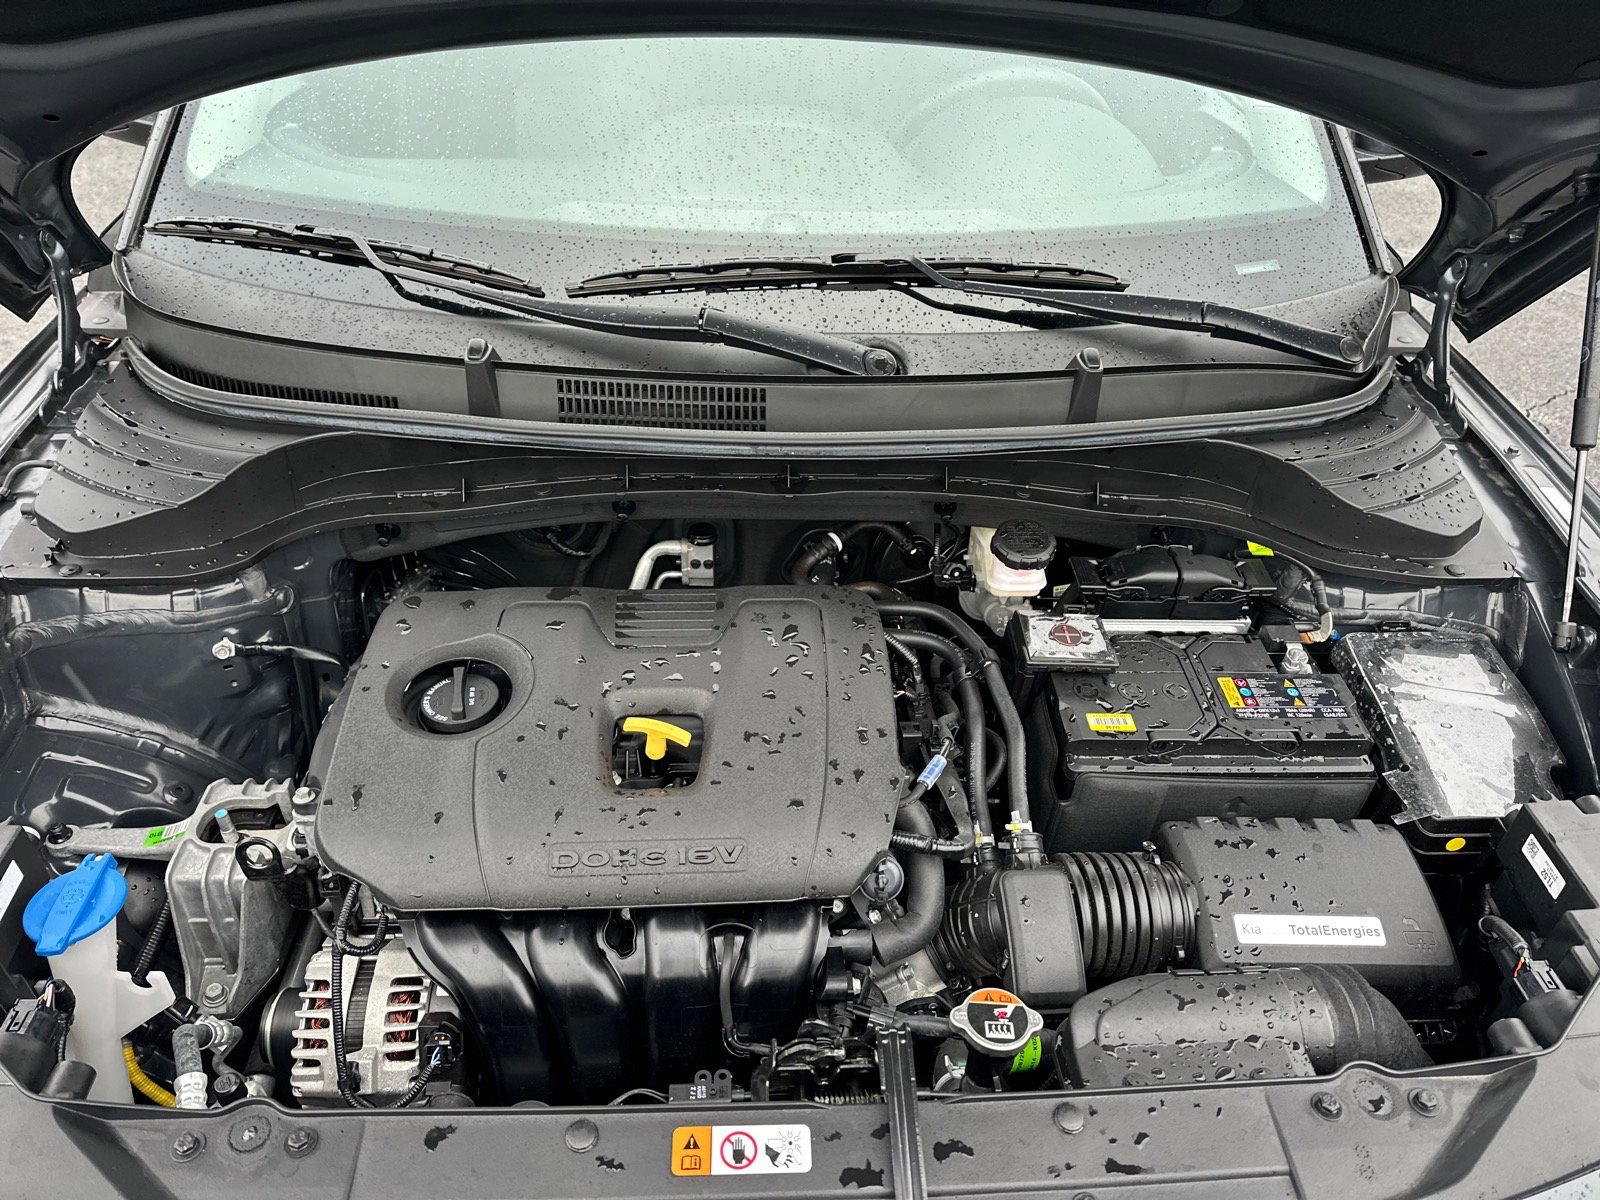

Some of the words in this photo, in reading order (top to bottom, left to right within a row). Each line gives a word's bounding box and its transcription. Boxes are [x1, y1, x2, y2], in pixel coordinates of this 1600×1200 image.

[426, 678, 452, 695] MANUAL
[551, 848, 667, 869] DOHC
[677, 845, 745, 866] 16V
[1241, 923, 1262, 936] Kia
[1288, 924, 1381, 939] TotalEnergies
